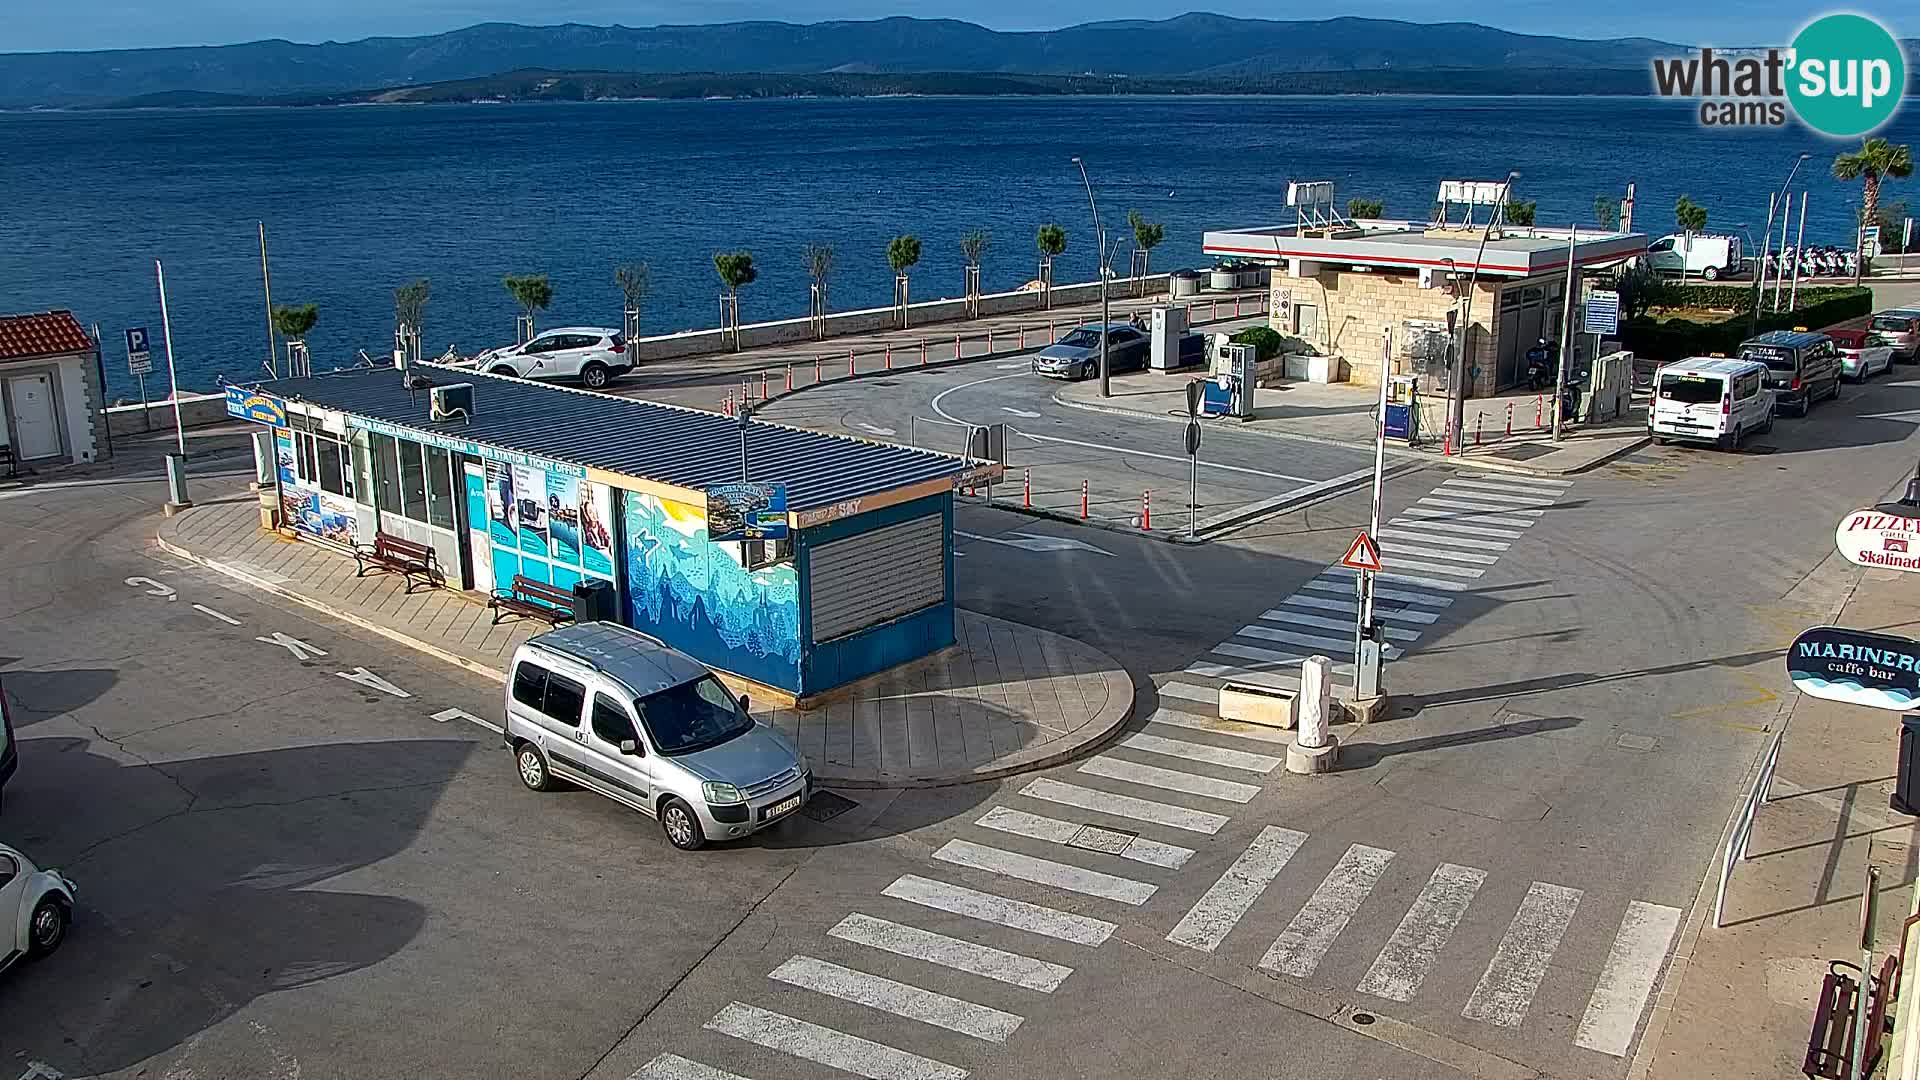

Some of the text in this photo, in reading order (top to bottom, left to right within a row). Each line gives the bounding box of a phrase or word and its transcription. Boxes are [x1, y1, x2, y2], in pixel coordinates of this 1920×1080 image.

[131, 331, 143, 350] P
[1757, 347, 1777, 356] TAXI
[437, 436, 468, 453] POSTAJA
[495, 449, 527, 464] STATION
[529, 456, 554, 471] TICKET
[556, 462, 582, 477] OFFICE
[1847, 515, 1920, 534] PIZZE
[1828, 662, 1896, 680] caffe bar
